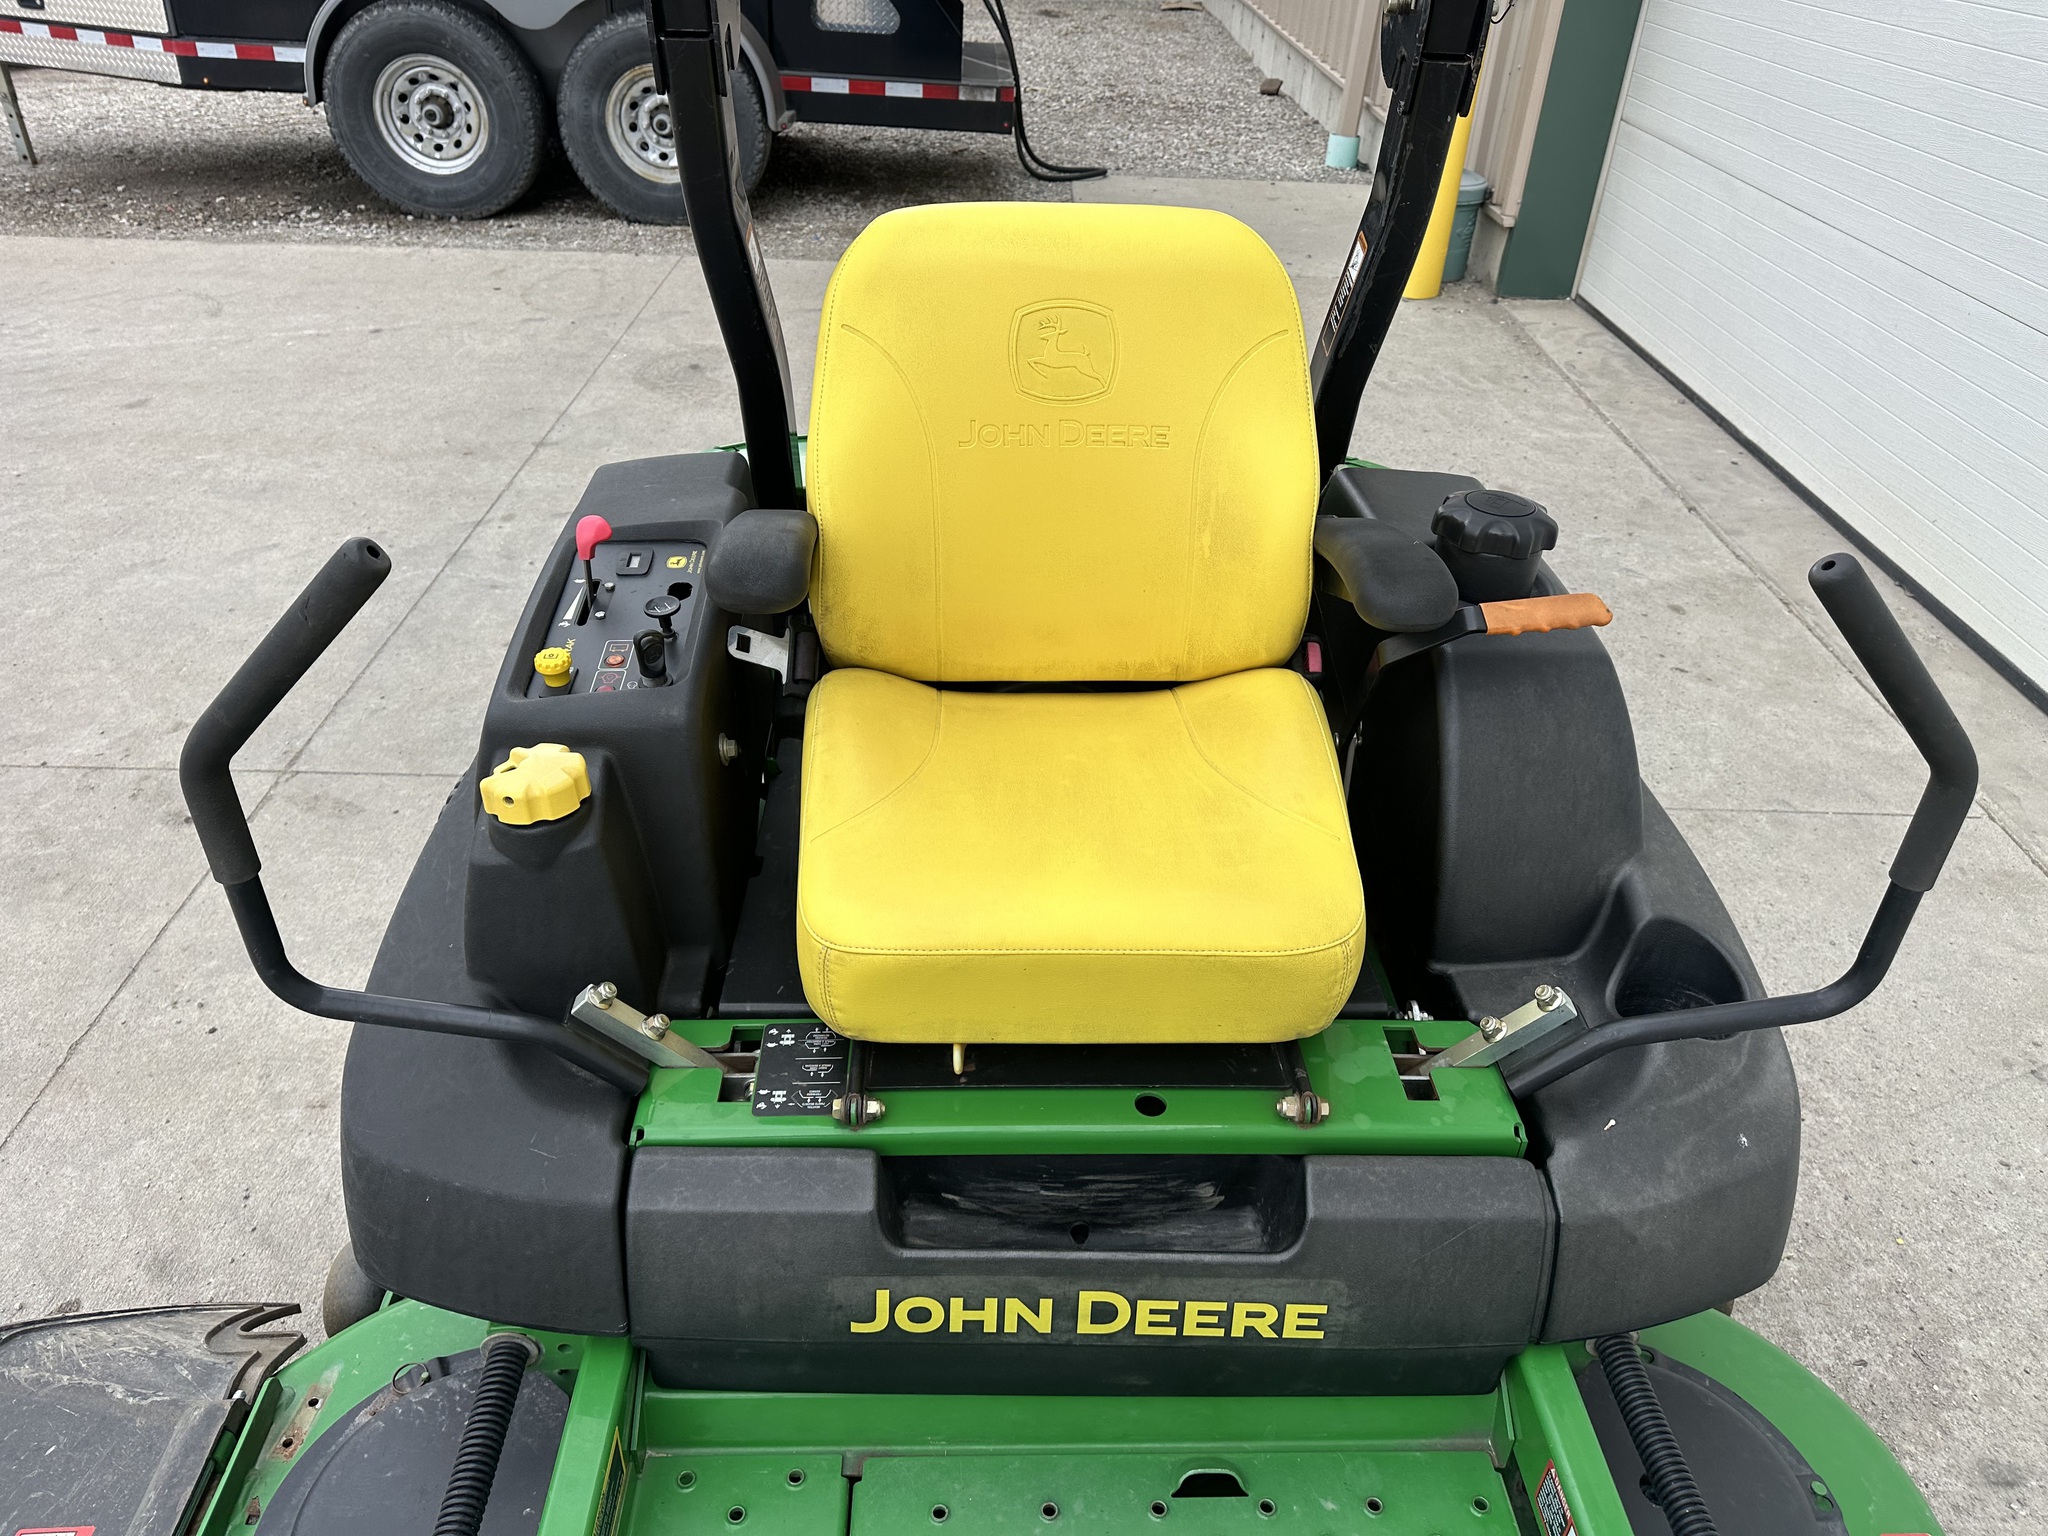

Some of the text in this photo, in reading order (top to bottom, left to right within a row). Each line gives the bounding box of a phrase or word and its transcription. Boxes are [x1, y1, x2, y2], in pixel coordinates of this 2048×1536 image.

[958, 419, 1171, 449] JOHN DEERE
[850, 1289, 1329, 1340] JOHN DEERE
